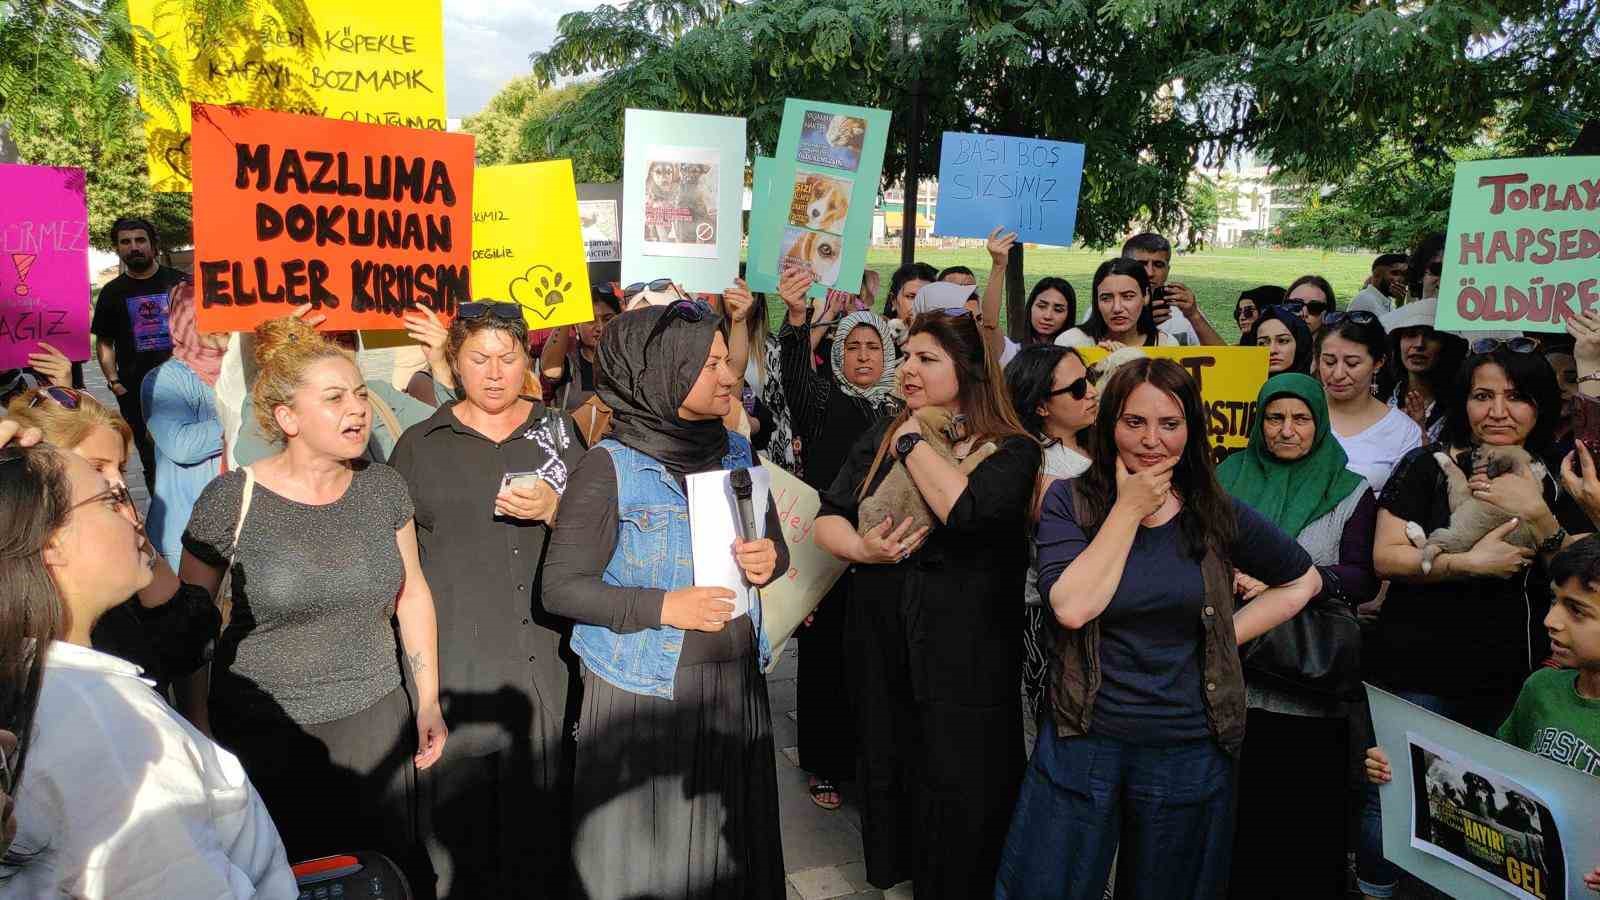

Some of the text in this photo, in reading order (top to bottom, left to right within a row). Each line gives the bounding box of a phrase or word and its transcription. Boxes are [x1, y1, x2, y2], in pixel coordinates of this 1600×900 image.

[325, 26, 417, 54] KÖPEKLE
[310, 67, 433, 94] BOZMADIK
[235, 143, 457, 207] MAZLUMA
[952, 138, 1062, 169] BAŞI BOŞ
[256, 202, 452, 252] DOKUNAN
[200, 256, 340, 309] ELLER
[1535, 727, 1600, 775] RSIT
[1505, 855, 1548, 900] GEL
